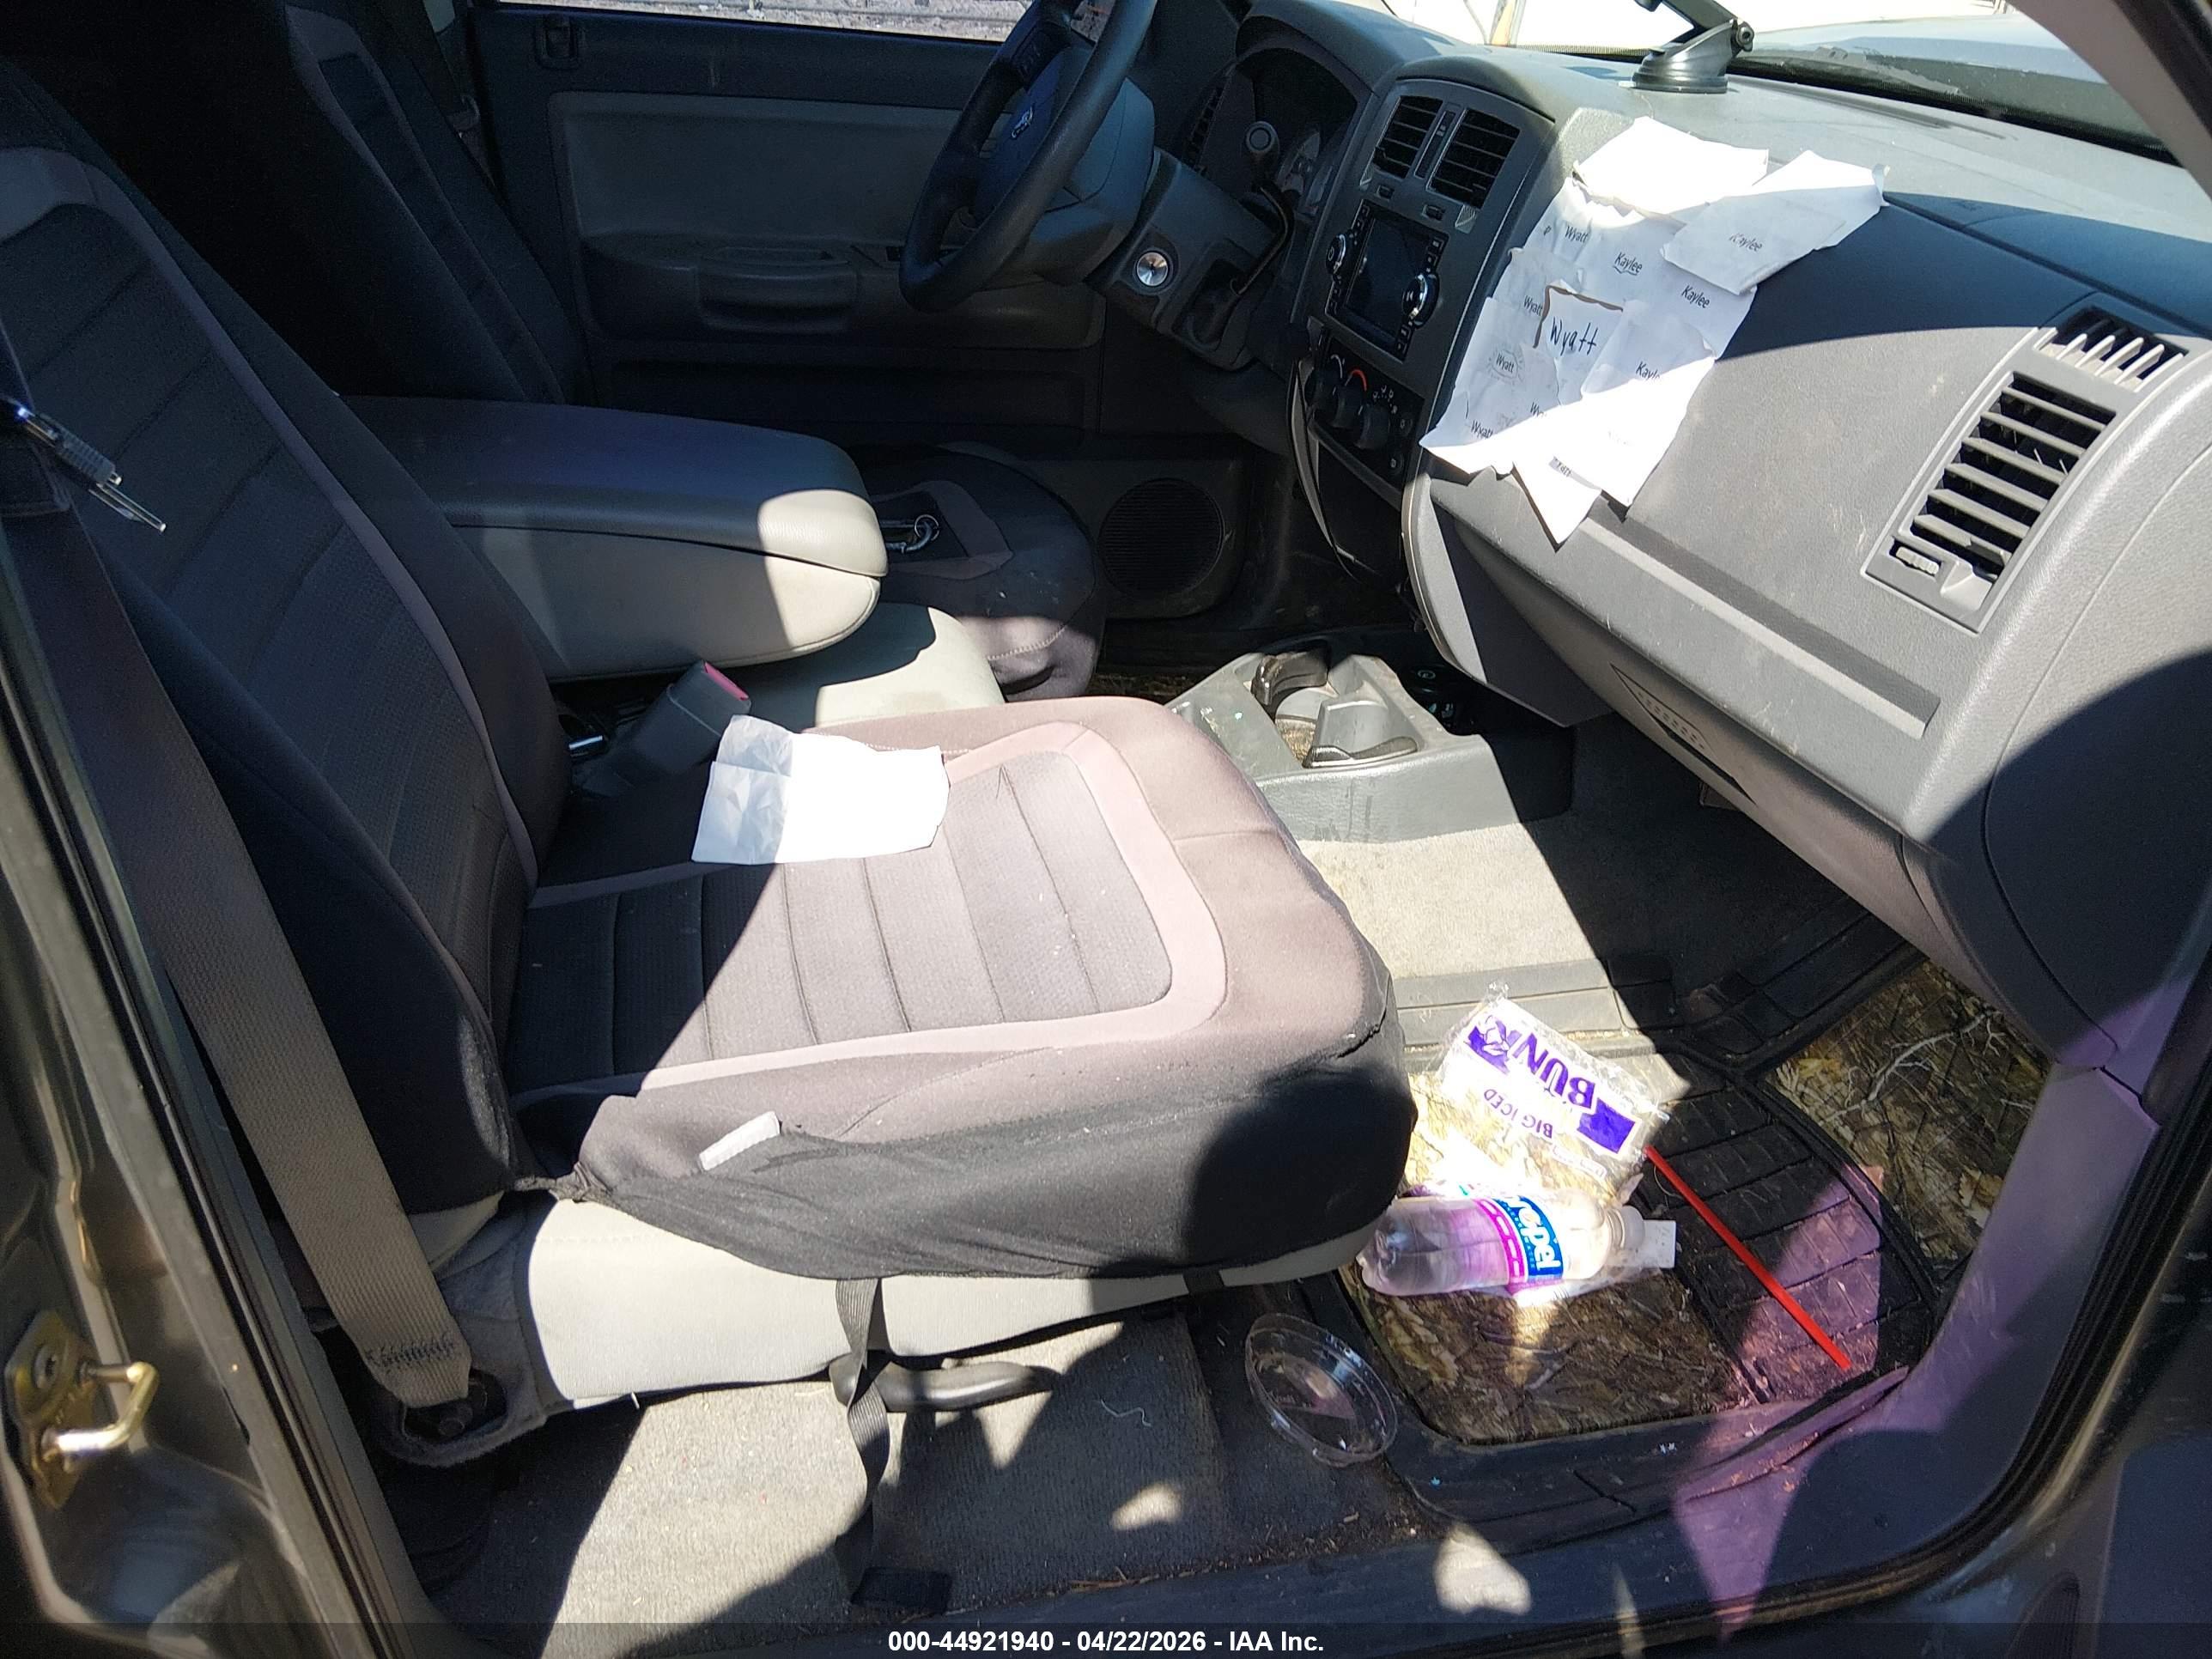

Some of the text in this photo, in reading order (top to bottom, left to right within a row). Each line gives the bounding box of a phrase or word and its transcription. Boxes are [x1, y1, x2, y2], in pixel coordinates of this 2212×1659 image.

[1614, 252, 1643, 274] Kaylee
[1680, 284, 1711, 309] Kaylee
[1550, 316, 1599, 356] Wyatt
[1496, 353, 1515, 374] Wyatt
[1483, 1088, 1554, 1139] BIG ICED
